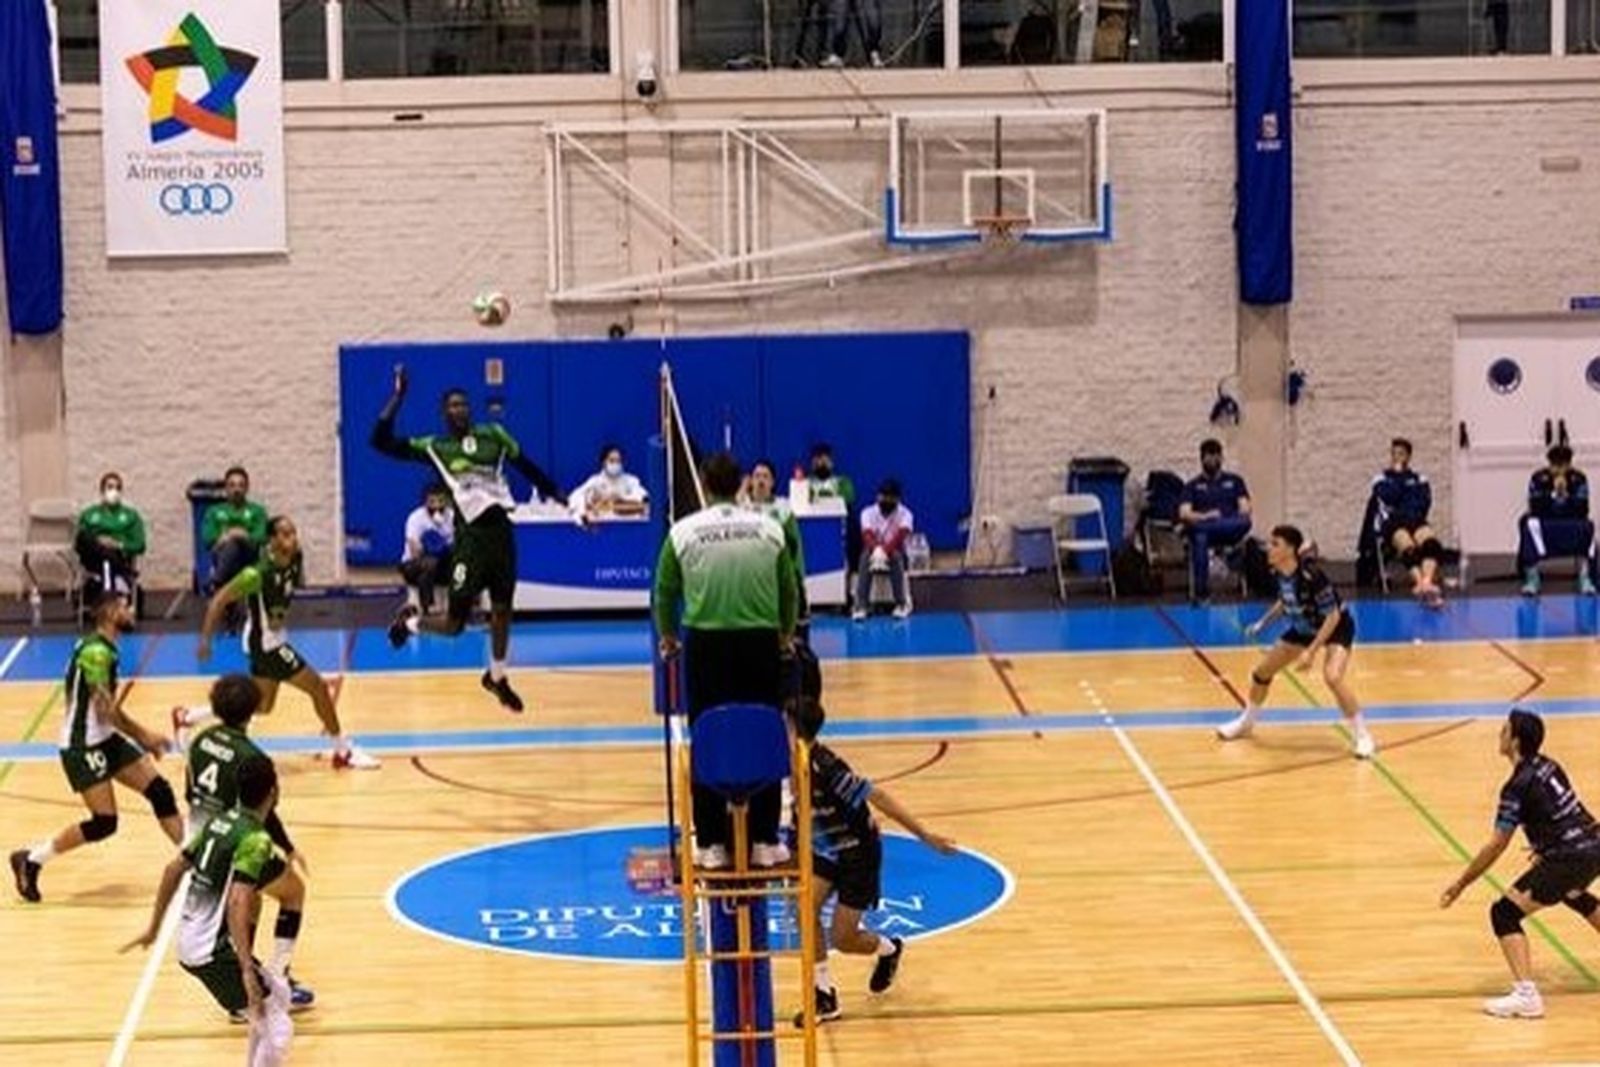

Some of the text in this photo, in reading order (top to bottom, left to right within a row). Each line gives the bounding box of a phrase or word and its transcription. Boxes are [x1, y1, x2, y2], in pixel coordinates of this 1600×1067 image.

[213, 160, 264, 179] 2005
[198, 761, 219, 794] 4
[200, 837, 216, 871] 1
[486, 924, 580, 942] DE
